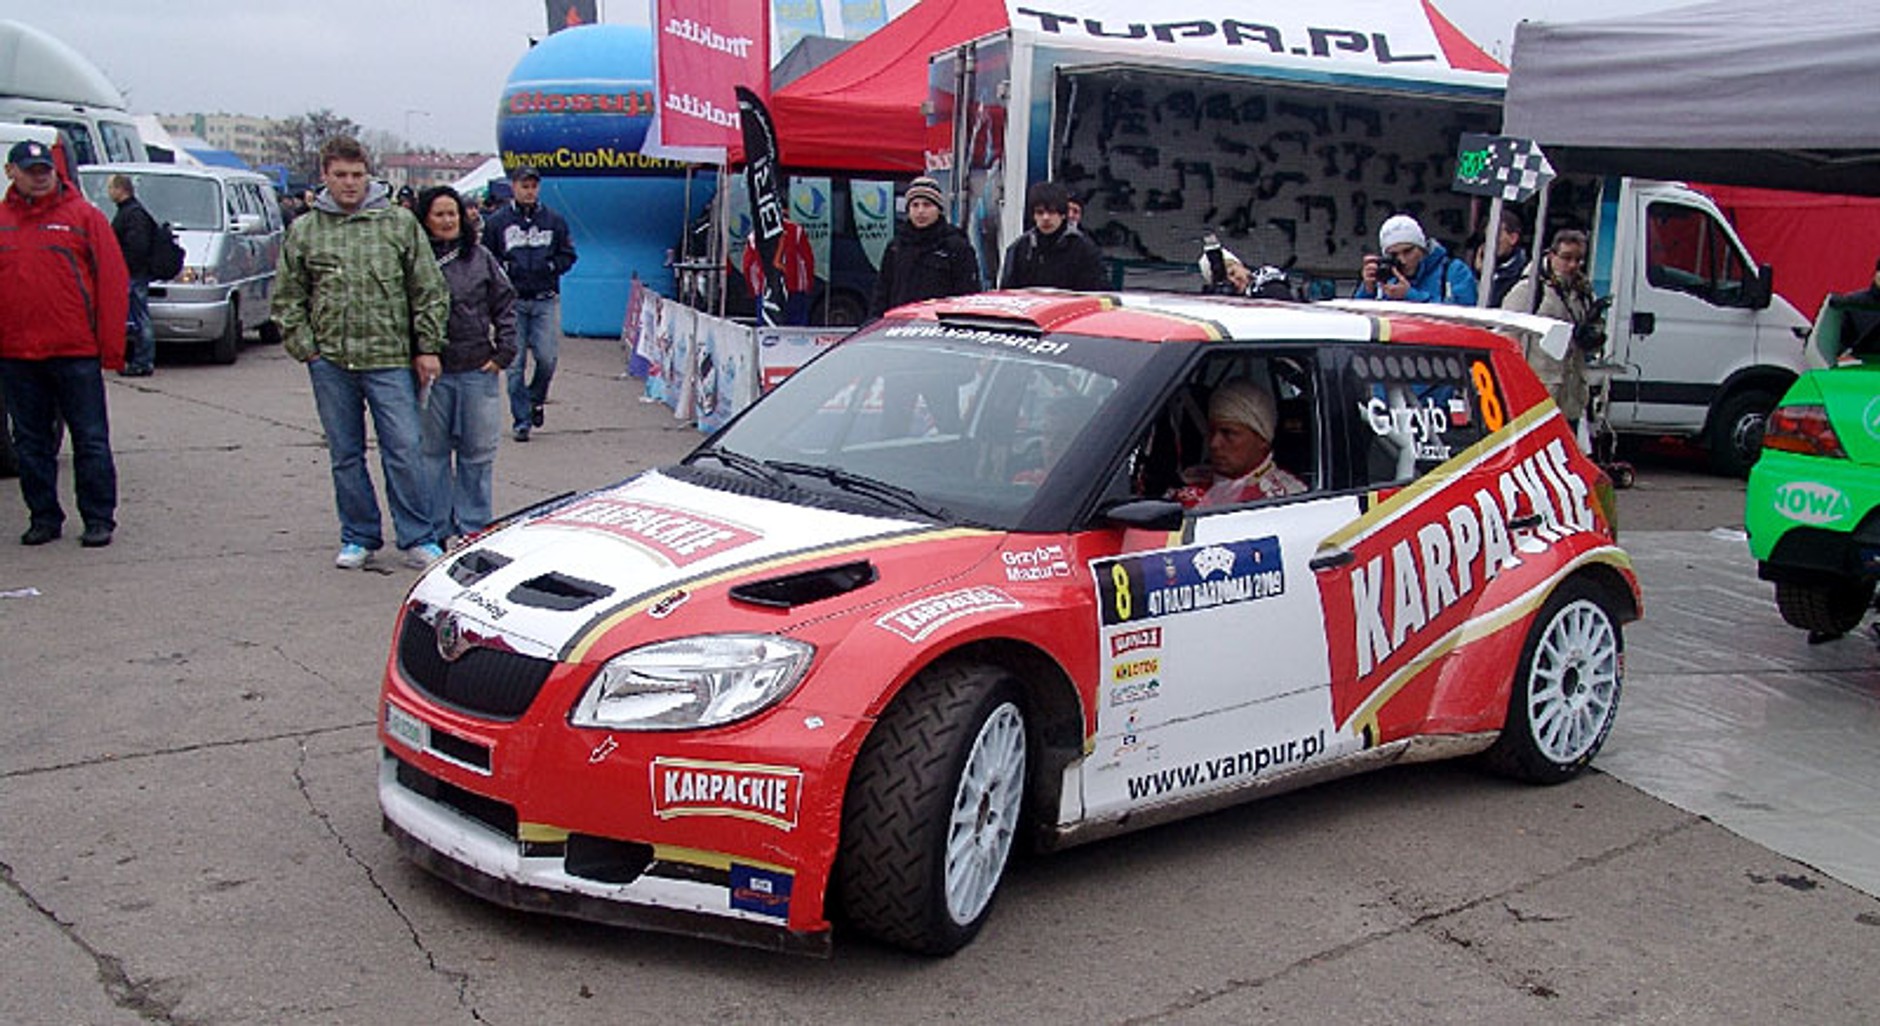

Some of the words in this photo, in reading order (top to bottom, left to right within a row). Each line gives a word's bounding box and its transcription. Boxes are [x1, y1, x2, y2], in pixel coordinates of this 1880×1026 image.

[1017, 6, 1437, 64] TUPA.PL
[885, 325, 1070, 355] www.vanpur.pl
[1367, 397, 1447, 443] Grzyb
[1470, 361, 1504, 432] 8
[1002, 547, 1050, 565] Grzyb
[1005, 565, 1053, 582] Mazur
[1350, 437, 1595, 681] KARPACKIE
[1112, 563, 1132, 620] 8
[1128, 729, 1325, 800] www.vanpur.pl
[664, 771, 789, 814] KARPACKIE
